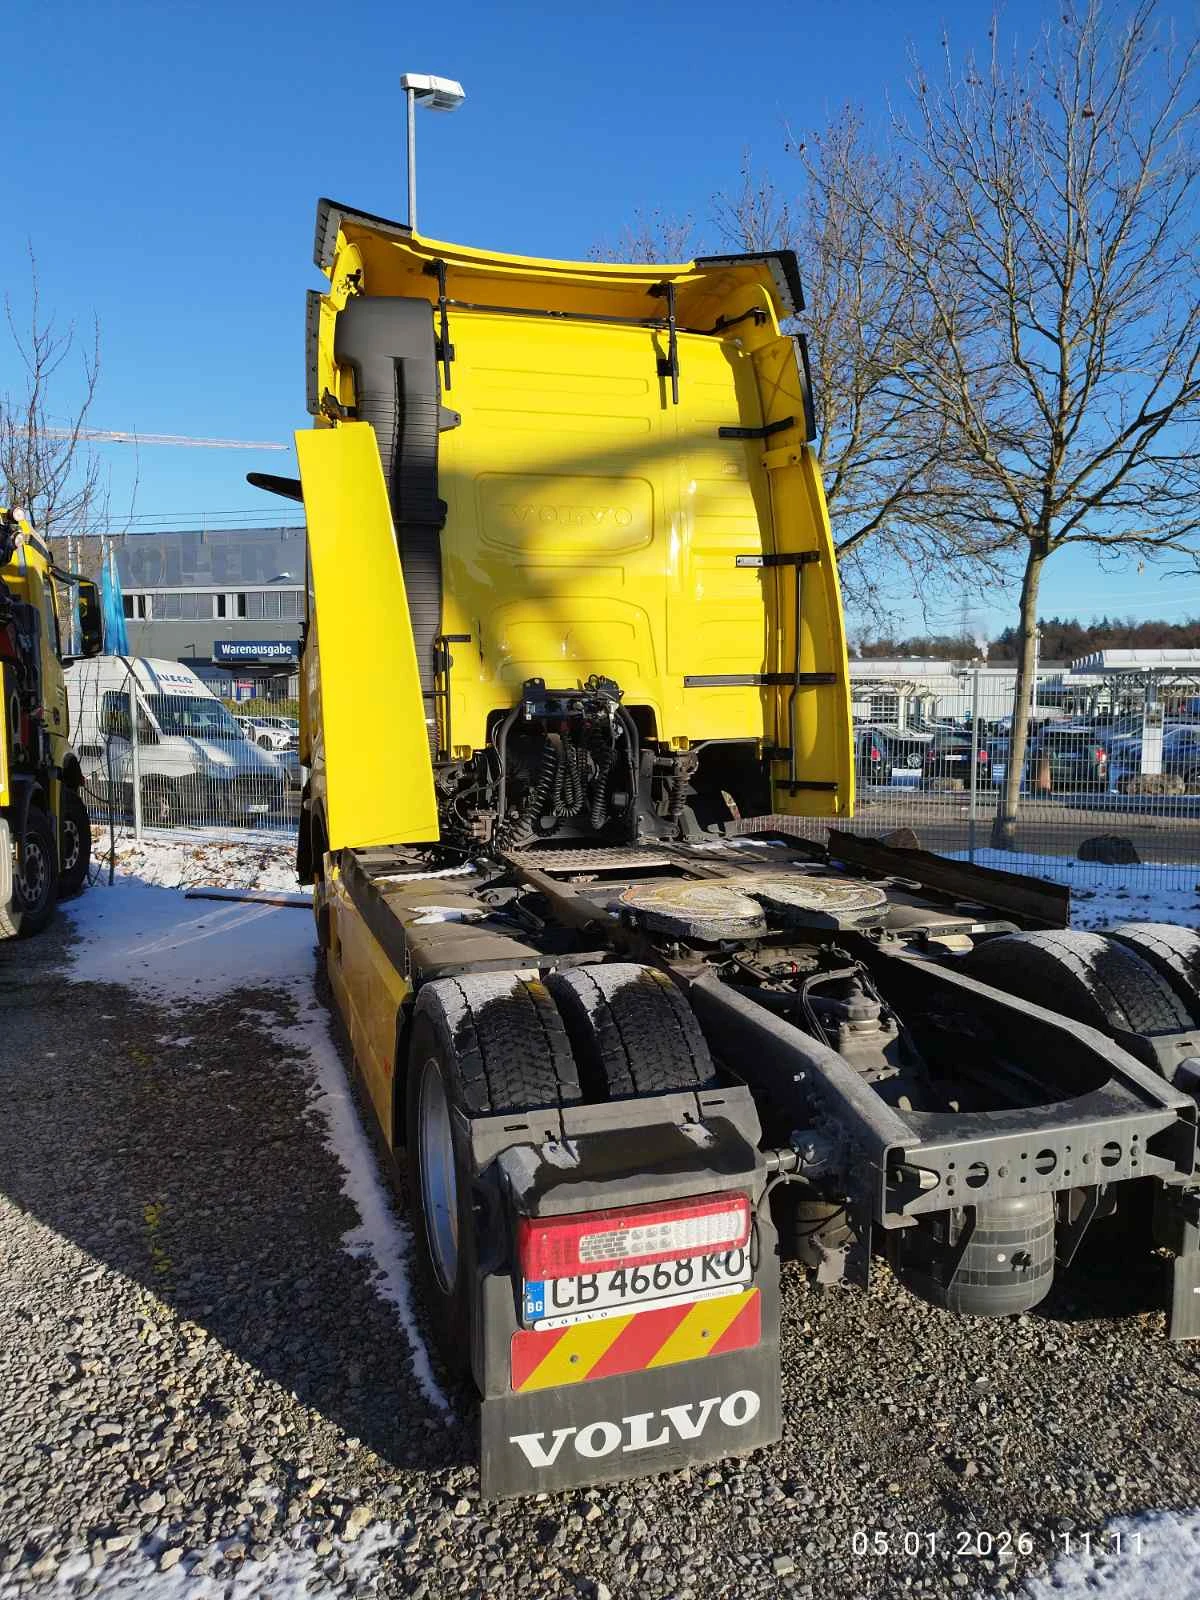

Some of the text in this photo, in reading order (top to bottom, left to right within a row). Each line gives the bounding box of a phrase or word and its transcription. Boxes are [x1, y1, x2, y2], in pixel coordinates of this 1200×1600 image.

[505, 503, 633, 528] VOLVO
[221, 643, 292, 656] Warenausgabe
[552, 1247, 745, 1309] CB 4668 KO
[527, 1300, 544, 1314] BG
[547, 1311, 608, 1328] VOLVO
[509, 1389, 761, 1468] VOLVO
